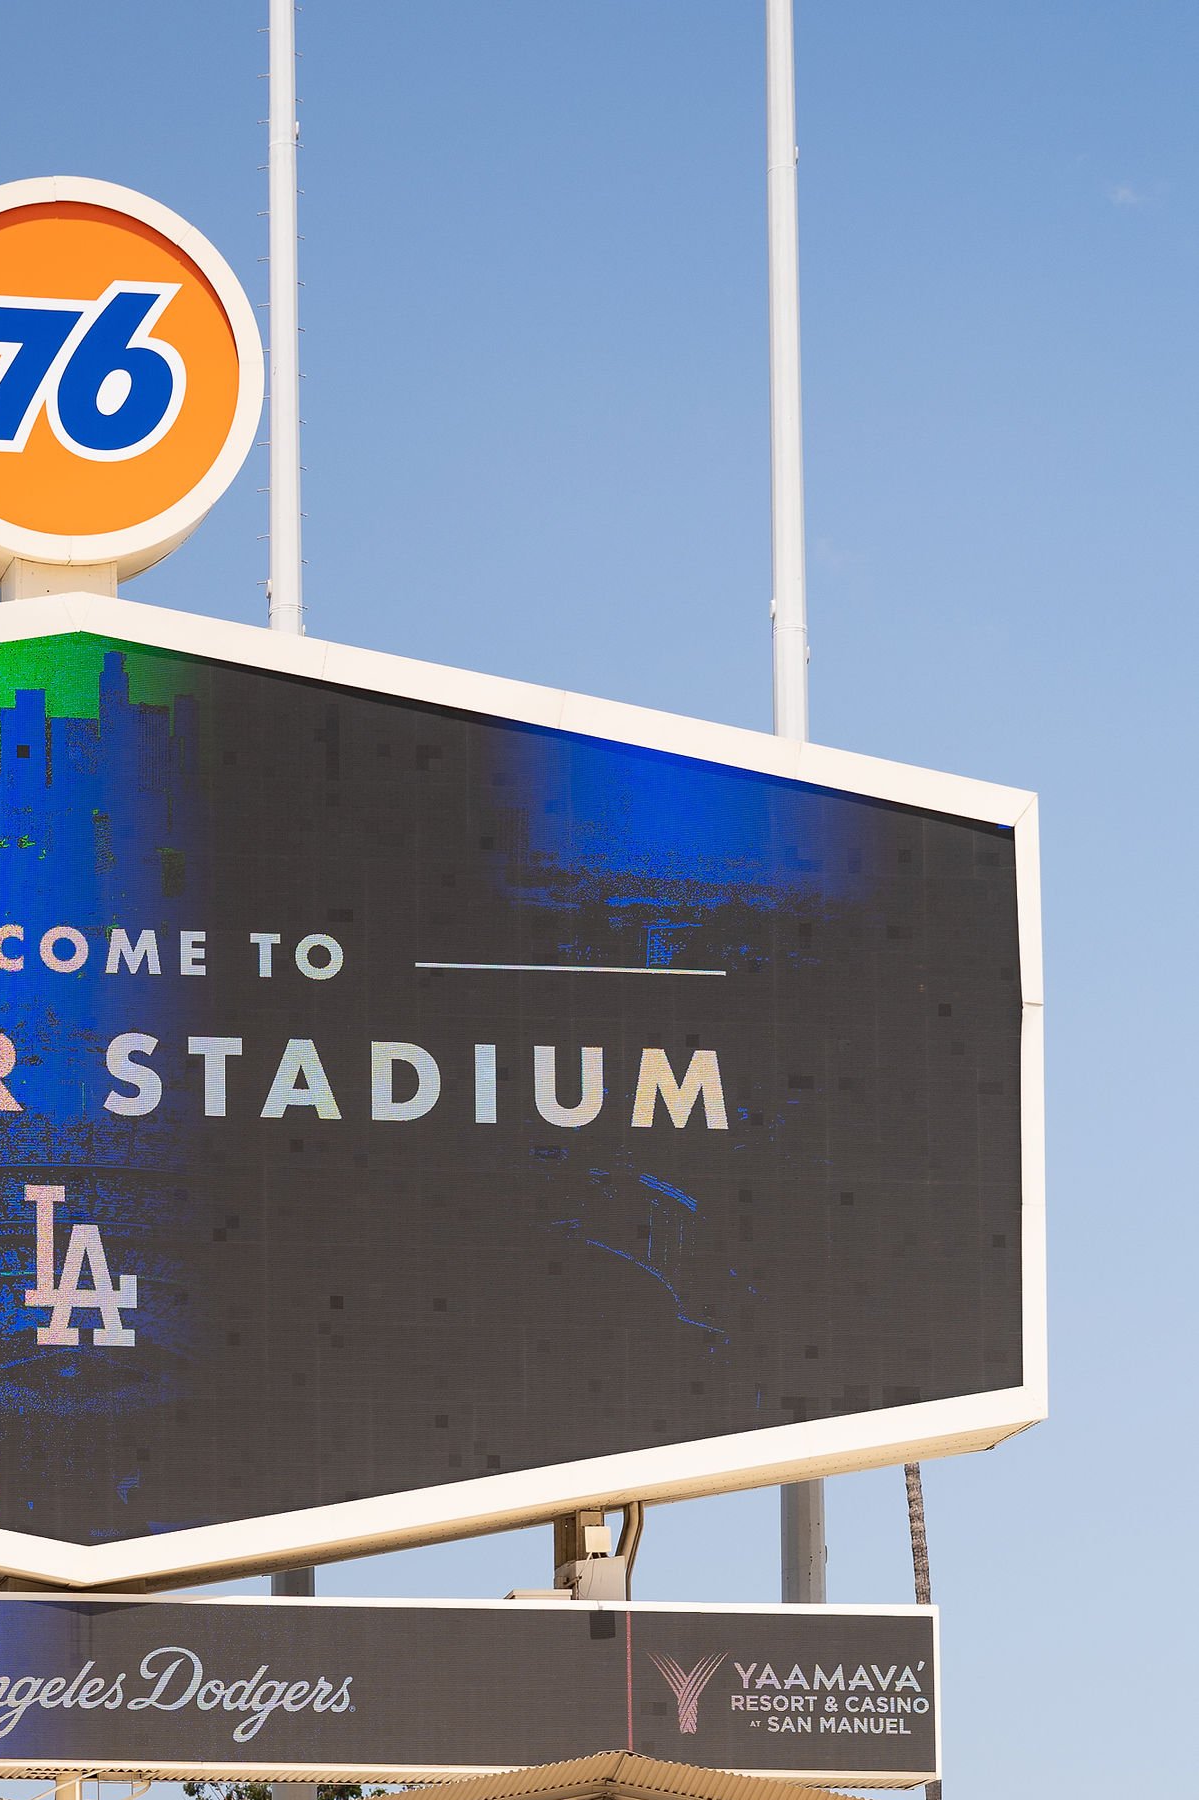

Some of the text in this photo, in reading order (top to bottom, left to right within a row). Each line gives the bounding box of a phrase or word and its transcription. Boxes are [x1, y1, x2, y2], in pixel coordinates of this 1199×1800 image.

[250, 932, 344, 981] TO
[103, 1032, 729, 1130] STADIUM
[24, 1185, 137, 1347] LA
[136, 1646, 350, 1743] Dodgers
[731, 1694, 930, 1714] RESORT & CASINO
[749, 1715, 912, 1735] AT SAN MANUEL
